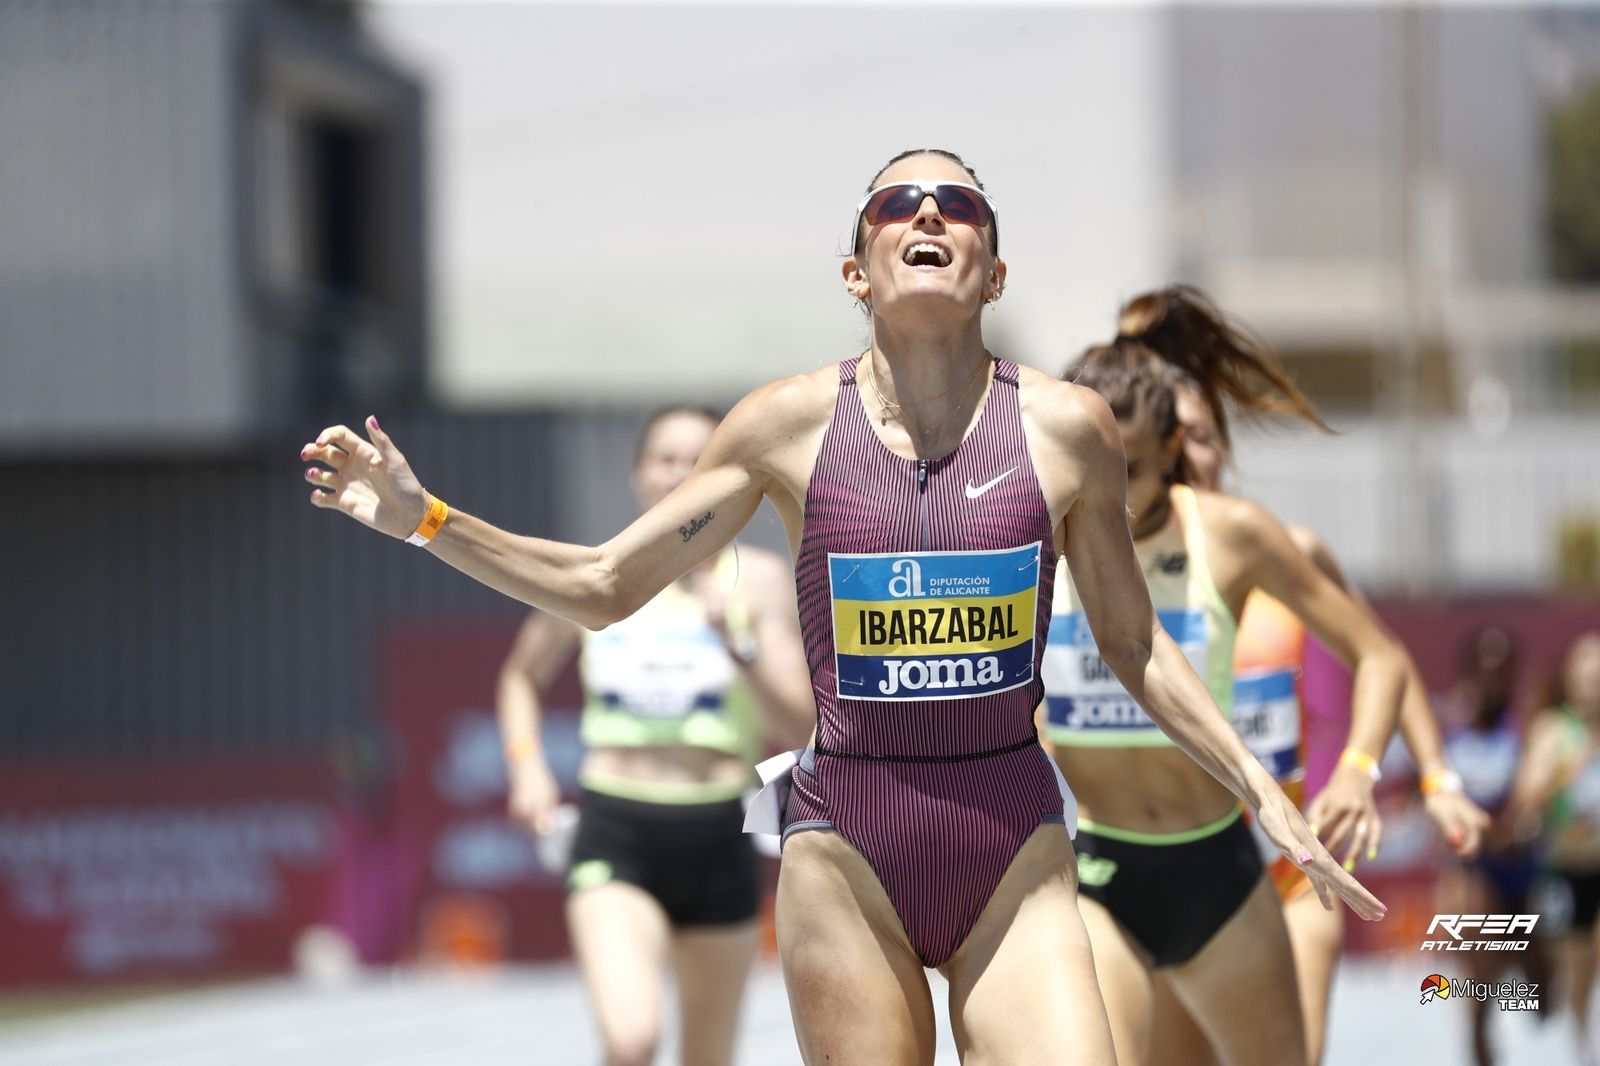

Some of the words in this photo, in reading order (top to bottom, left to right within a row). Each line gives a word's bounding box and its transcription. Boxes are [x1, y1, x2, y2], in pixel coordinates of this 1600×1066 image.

[929, 575, 990, 586] DIPUTACIÓN
[930, 588, 943, 596] DE
[945, 586, 990, 596] ALICANTE
[860, 604, 1018, 645] IBARZABAL
